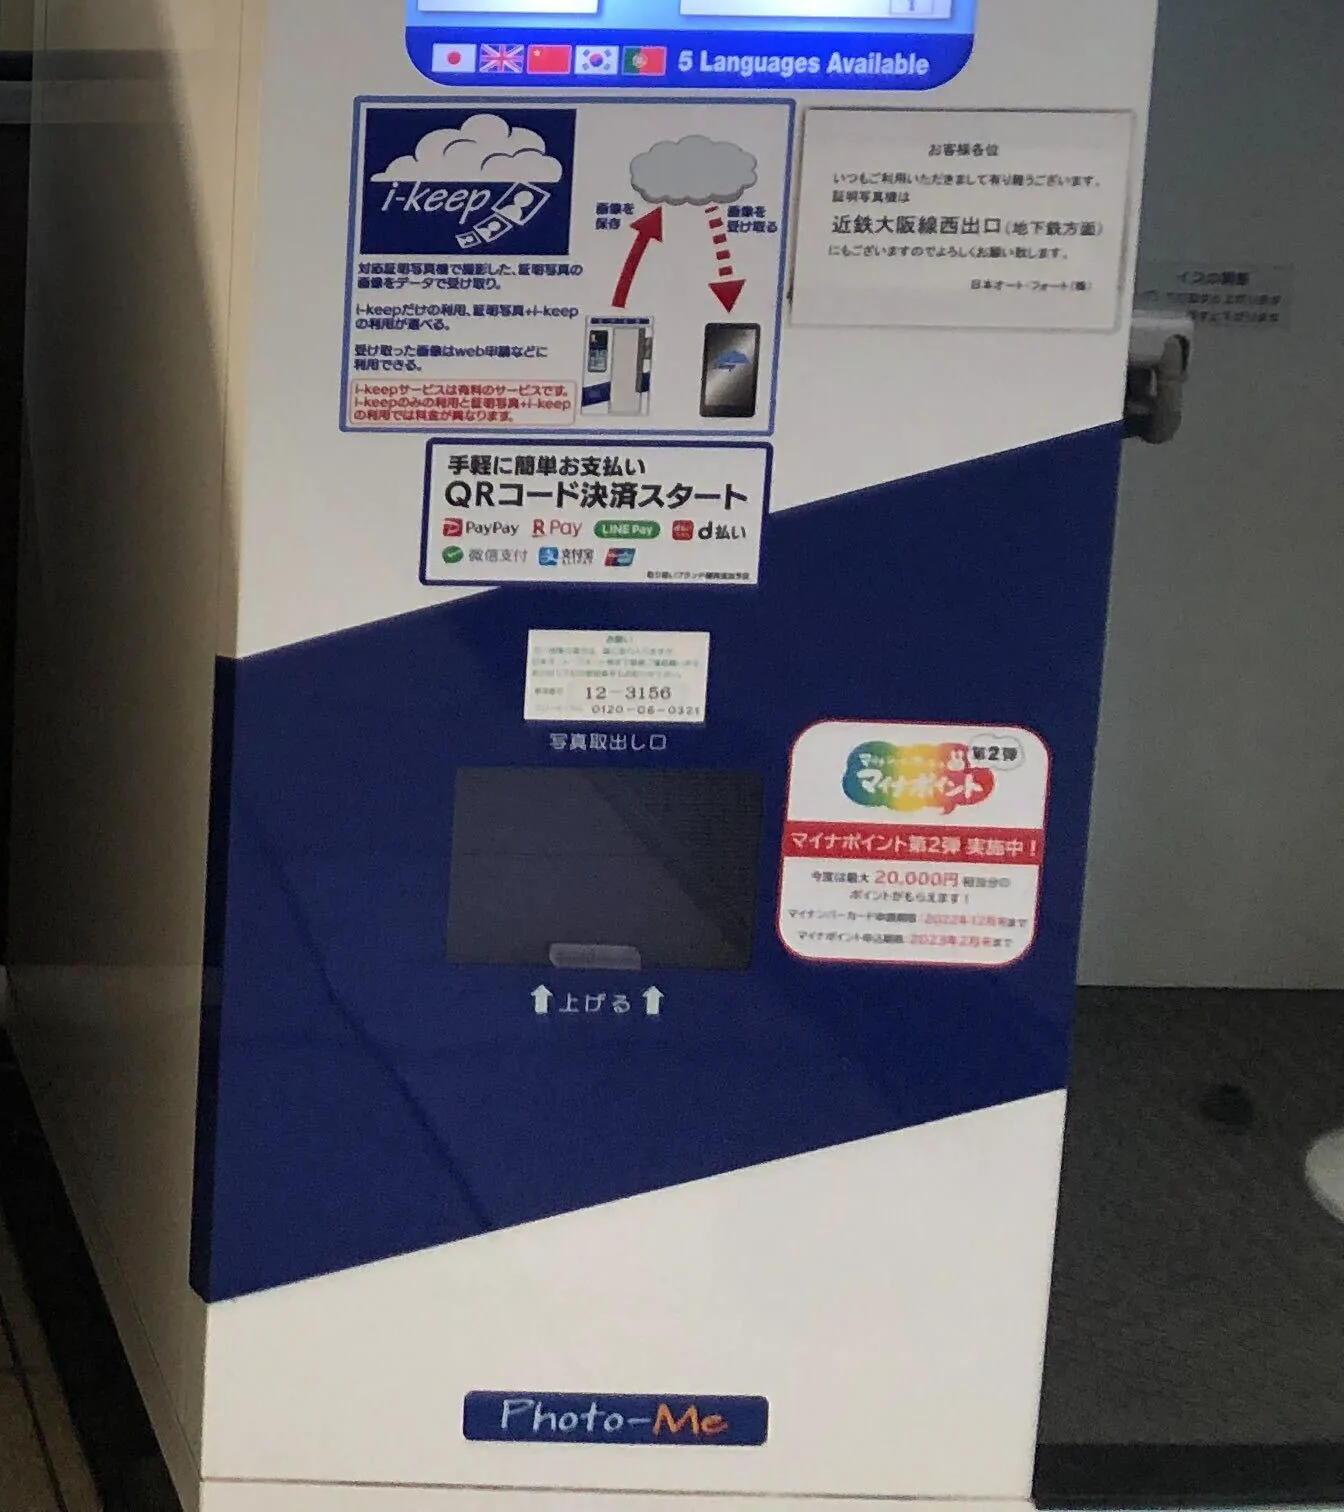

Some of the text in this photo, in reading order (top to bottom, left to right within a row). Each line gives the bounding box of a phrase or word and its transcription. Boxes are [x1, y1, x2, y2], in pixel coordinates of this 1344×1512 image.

[678, 50, 929, 78] 5 Languages Available
[381, 181, 490, 224] i-keep
[448, 454, 646, 476] 手軽に簡単お支払い
[445, 481, 748, 509] QRコード決済スタート
[465, 521, 519, 536] PayPay
[550, 520, 582, 537] Pay
[602, 524, 629, 535] LINE
[632, 525, 653, 537] Pay
[550, 733, 666, 750] 写真取出し口
[857, 769, 984, 798] マイナポイント
[558, 991, 631, 1014] 上げる
[501, 1399, 728, 1438] Photo-Me
